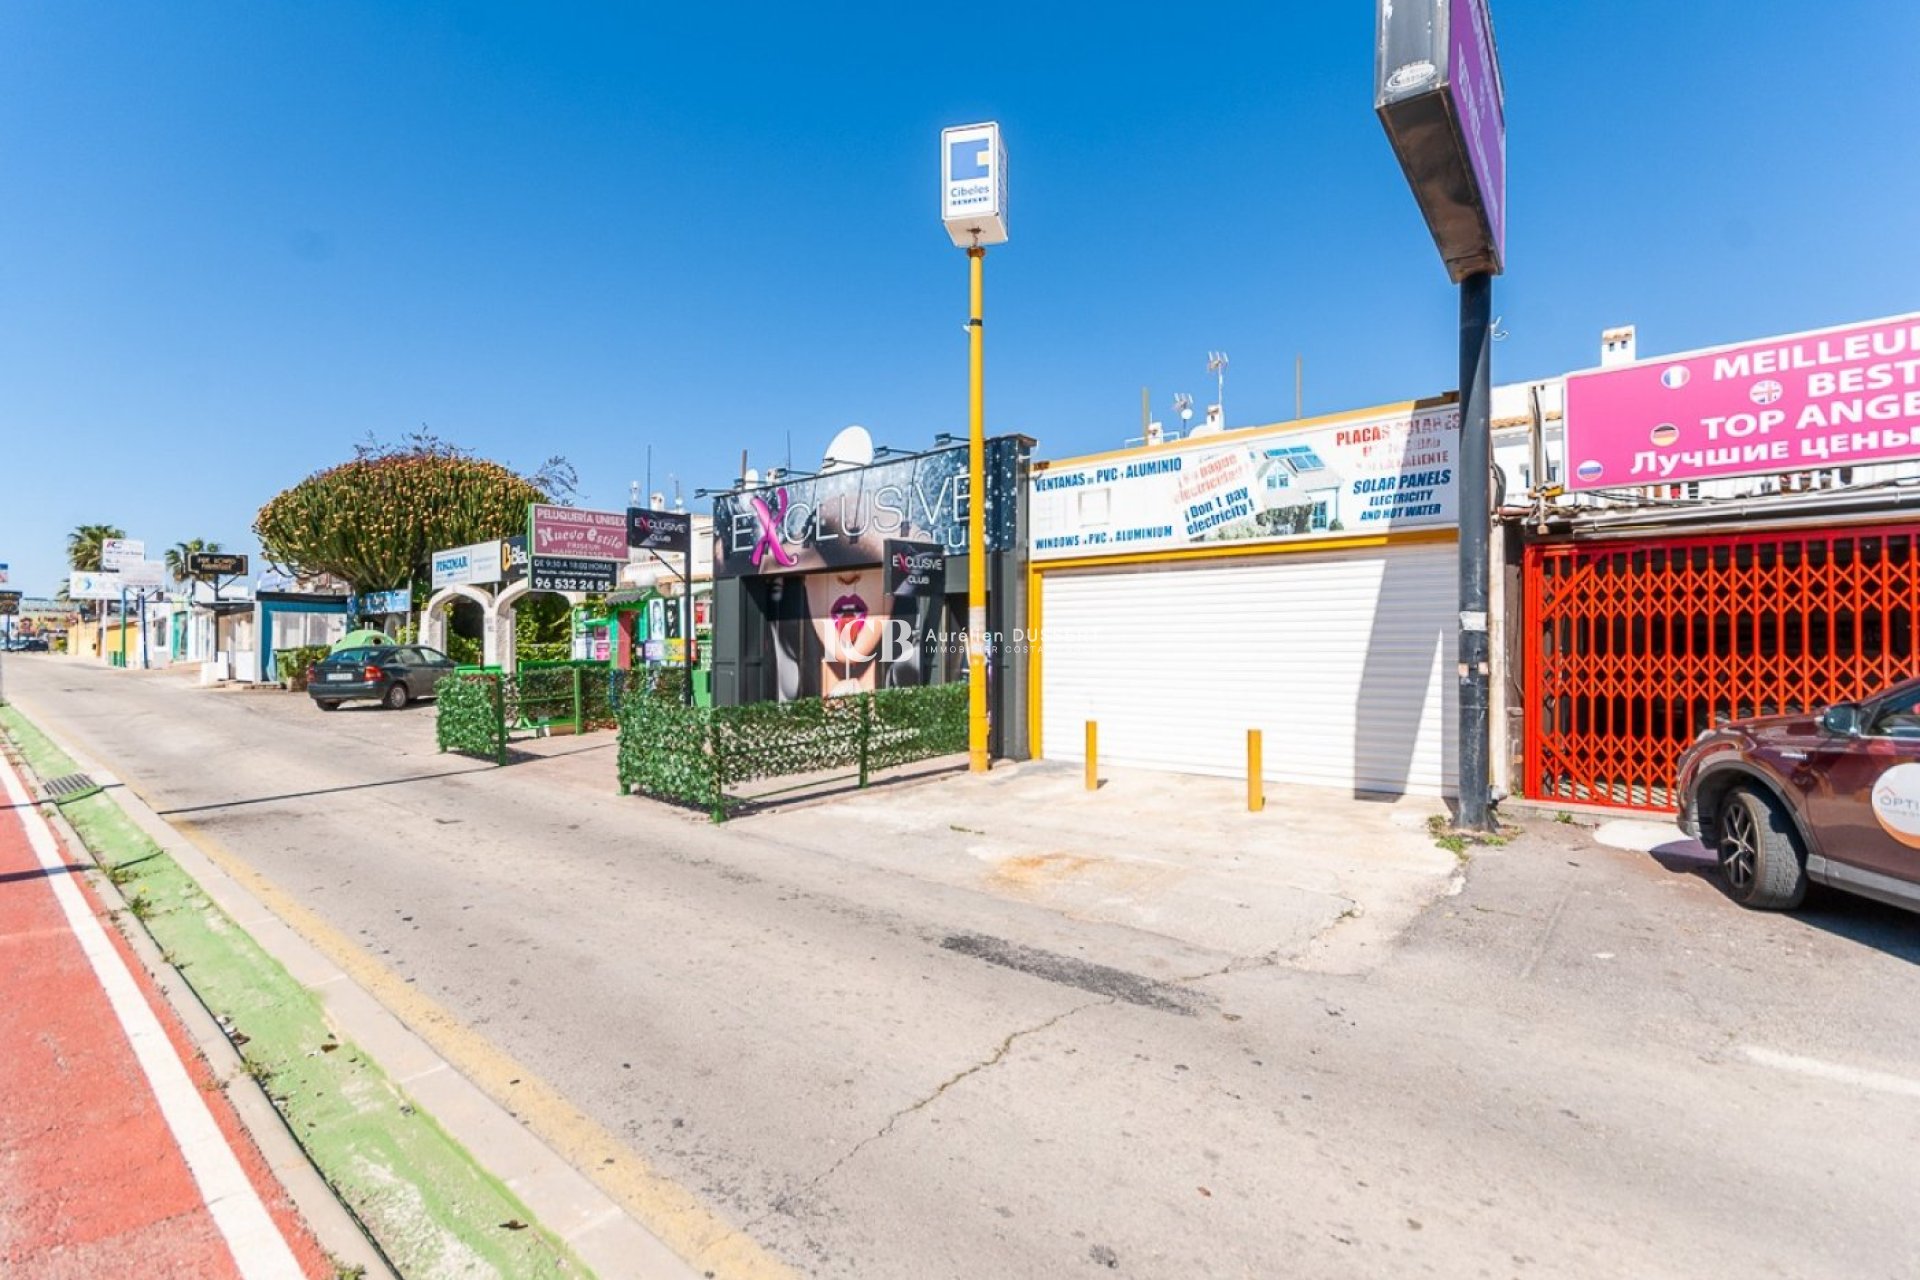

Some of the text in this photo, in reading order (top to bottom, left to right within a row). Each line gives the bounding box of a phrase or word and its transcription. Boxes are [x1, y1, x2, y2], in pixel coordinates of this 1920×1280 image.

[951, 184, 989, 197] Cibeles
[1807, 358, 1920, 397] BEST
[1700, 410, 1785, 440] TOP
[1035, 472, 1085, 493] VENTANAS
[1096, 467, 1118, 484] PVC
[1125, 456, 1182, 479] ALUMINIO
[1353, 468, 1452, 495] SOLAR PANELS
[1225, 486, 1249, 506] pay
[1370, 488, 1434, 507] ELECTRICITY
[536, 507, 626, 527] PELUQUERÍA UNISEX
[732, 474, 971, 568] EXCLUSIVE
[1361, 502, 1442, 521] AND HOT WATER
[634, 513, 688, 533] EXCLUSIVE
[537, 526, 585, 547] Nuevo
[1035, 534, 1079, 550] WINDOWS
[1088, 531, 1106, 545] PVC
[1115, 524, 1173, 542] ALUMINIUM
[891, 552, 943, 573] EXCLUSIVE
[535, 576, 611, 592] 96 532 24 55
[907, 574, 931, 585] CLUB
